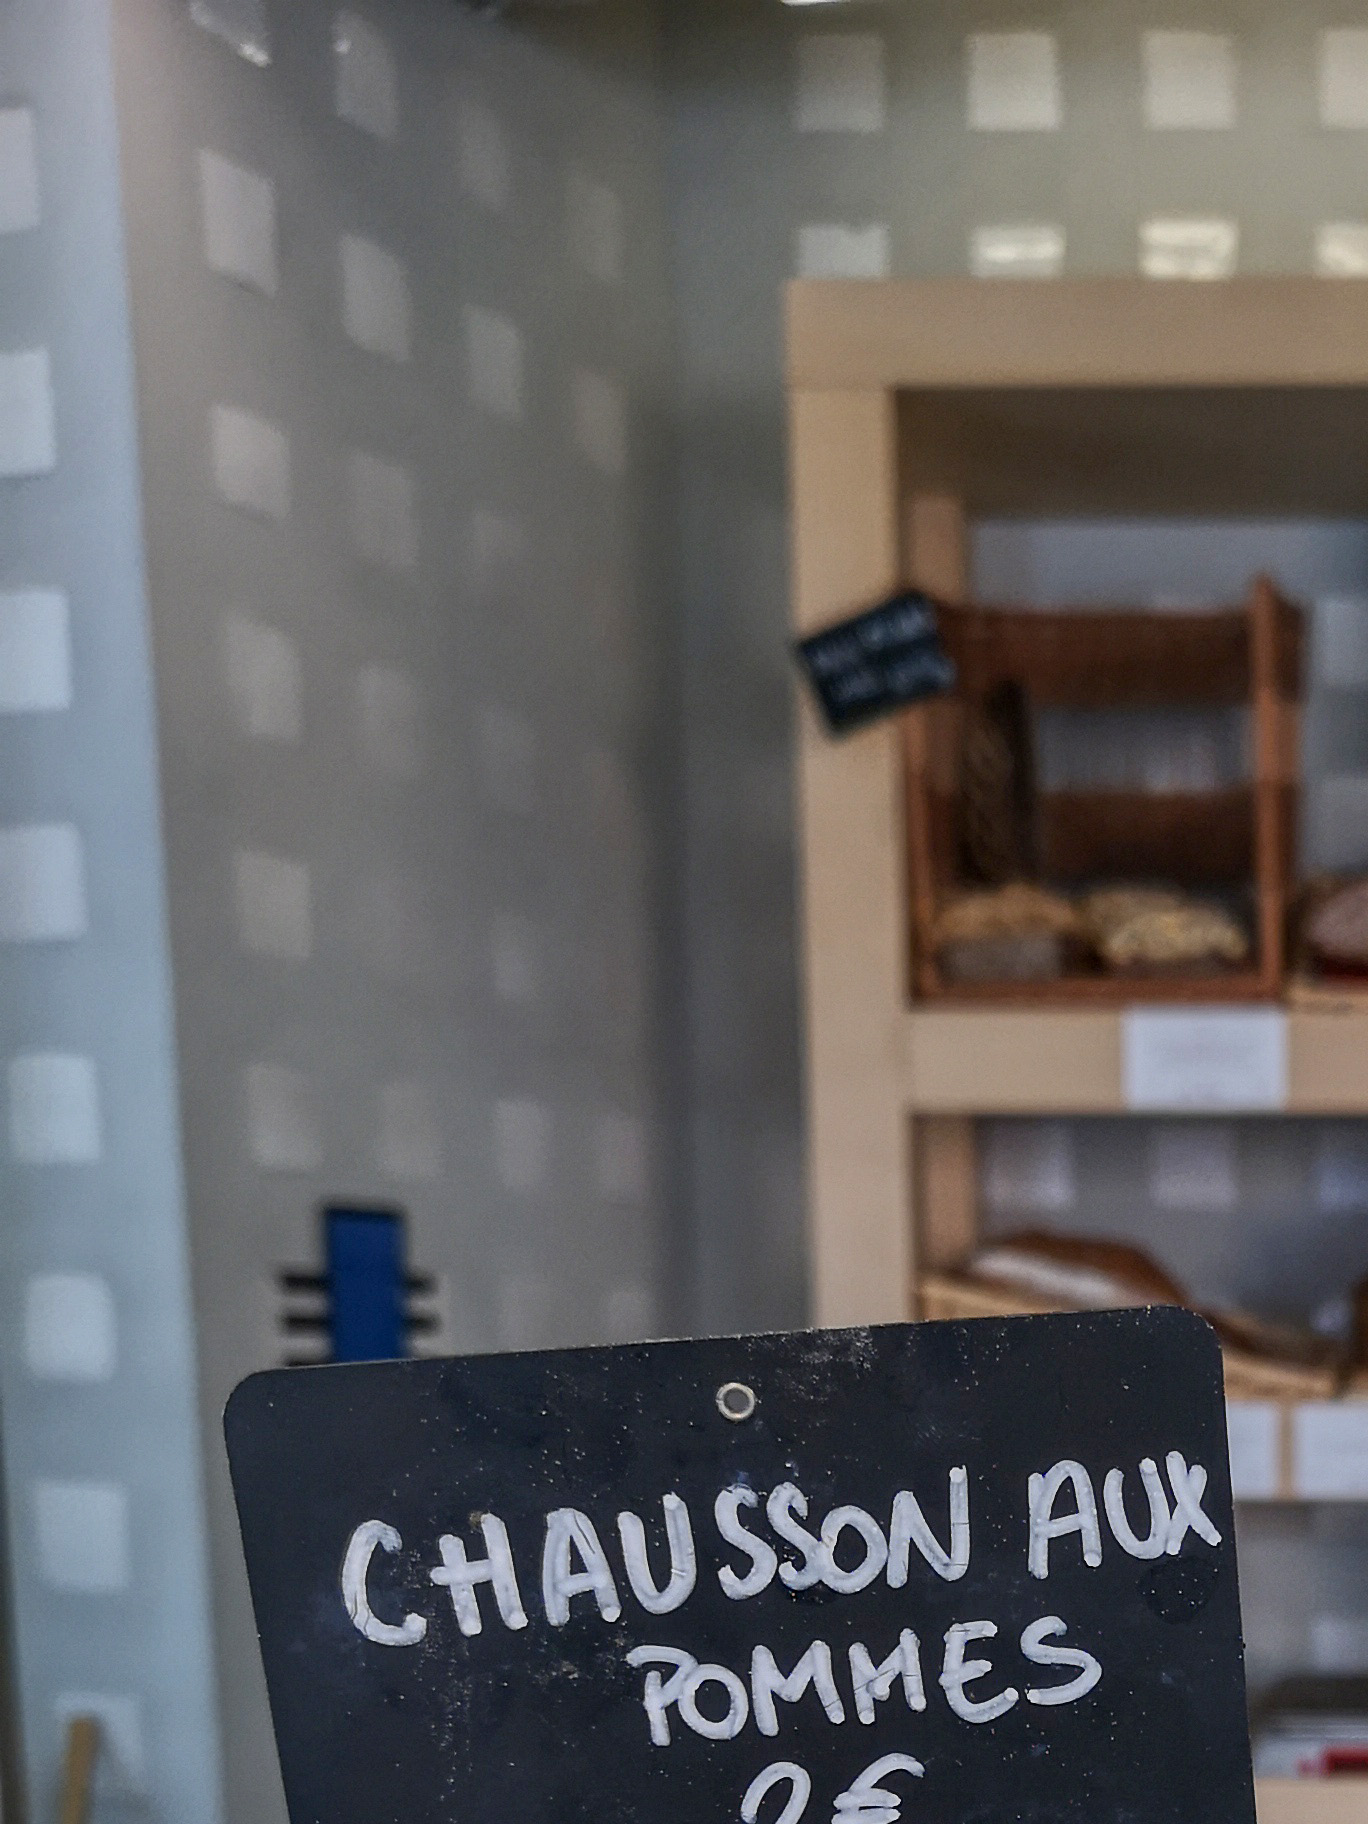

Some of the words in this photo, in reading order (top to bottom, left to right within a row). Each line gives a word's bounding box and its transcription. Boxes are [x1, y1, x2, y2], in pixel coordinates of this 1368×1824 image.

[340, 1463, 972, 1647] CHAUSSON
[1026, 1449, 1223, 1581] AUX
[624, 1615, 1103, 1748] POMMES
